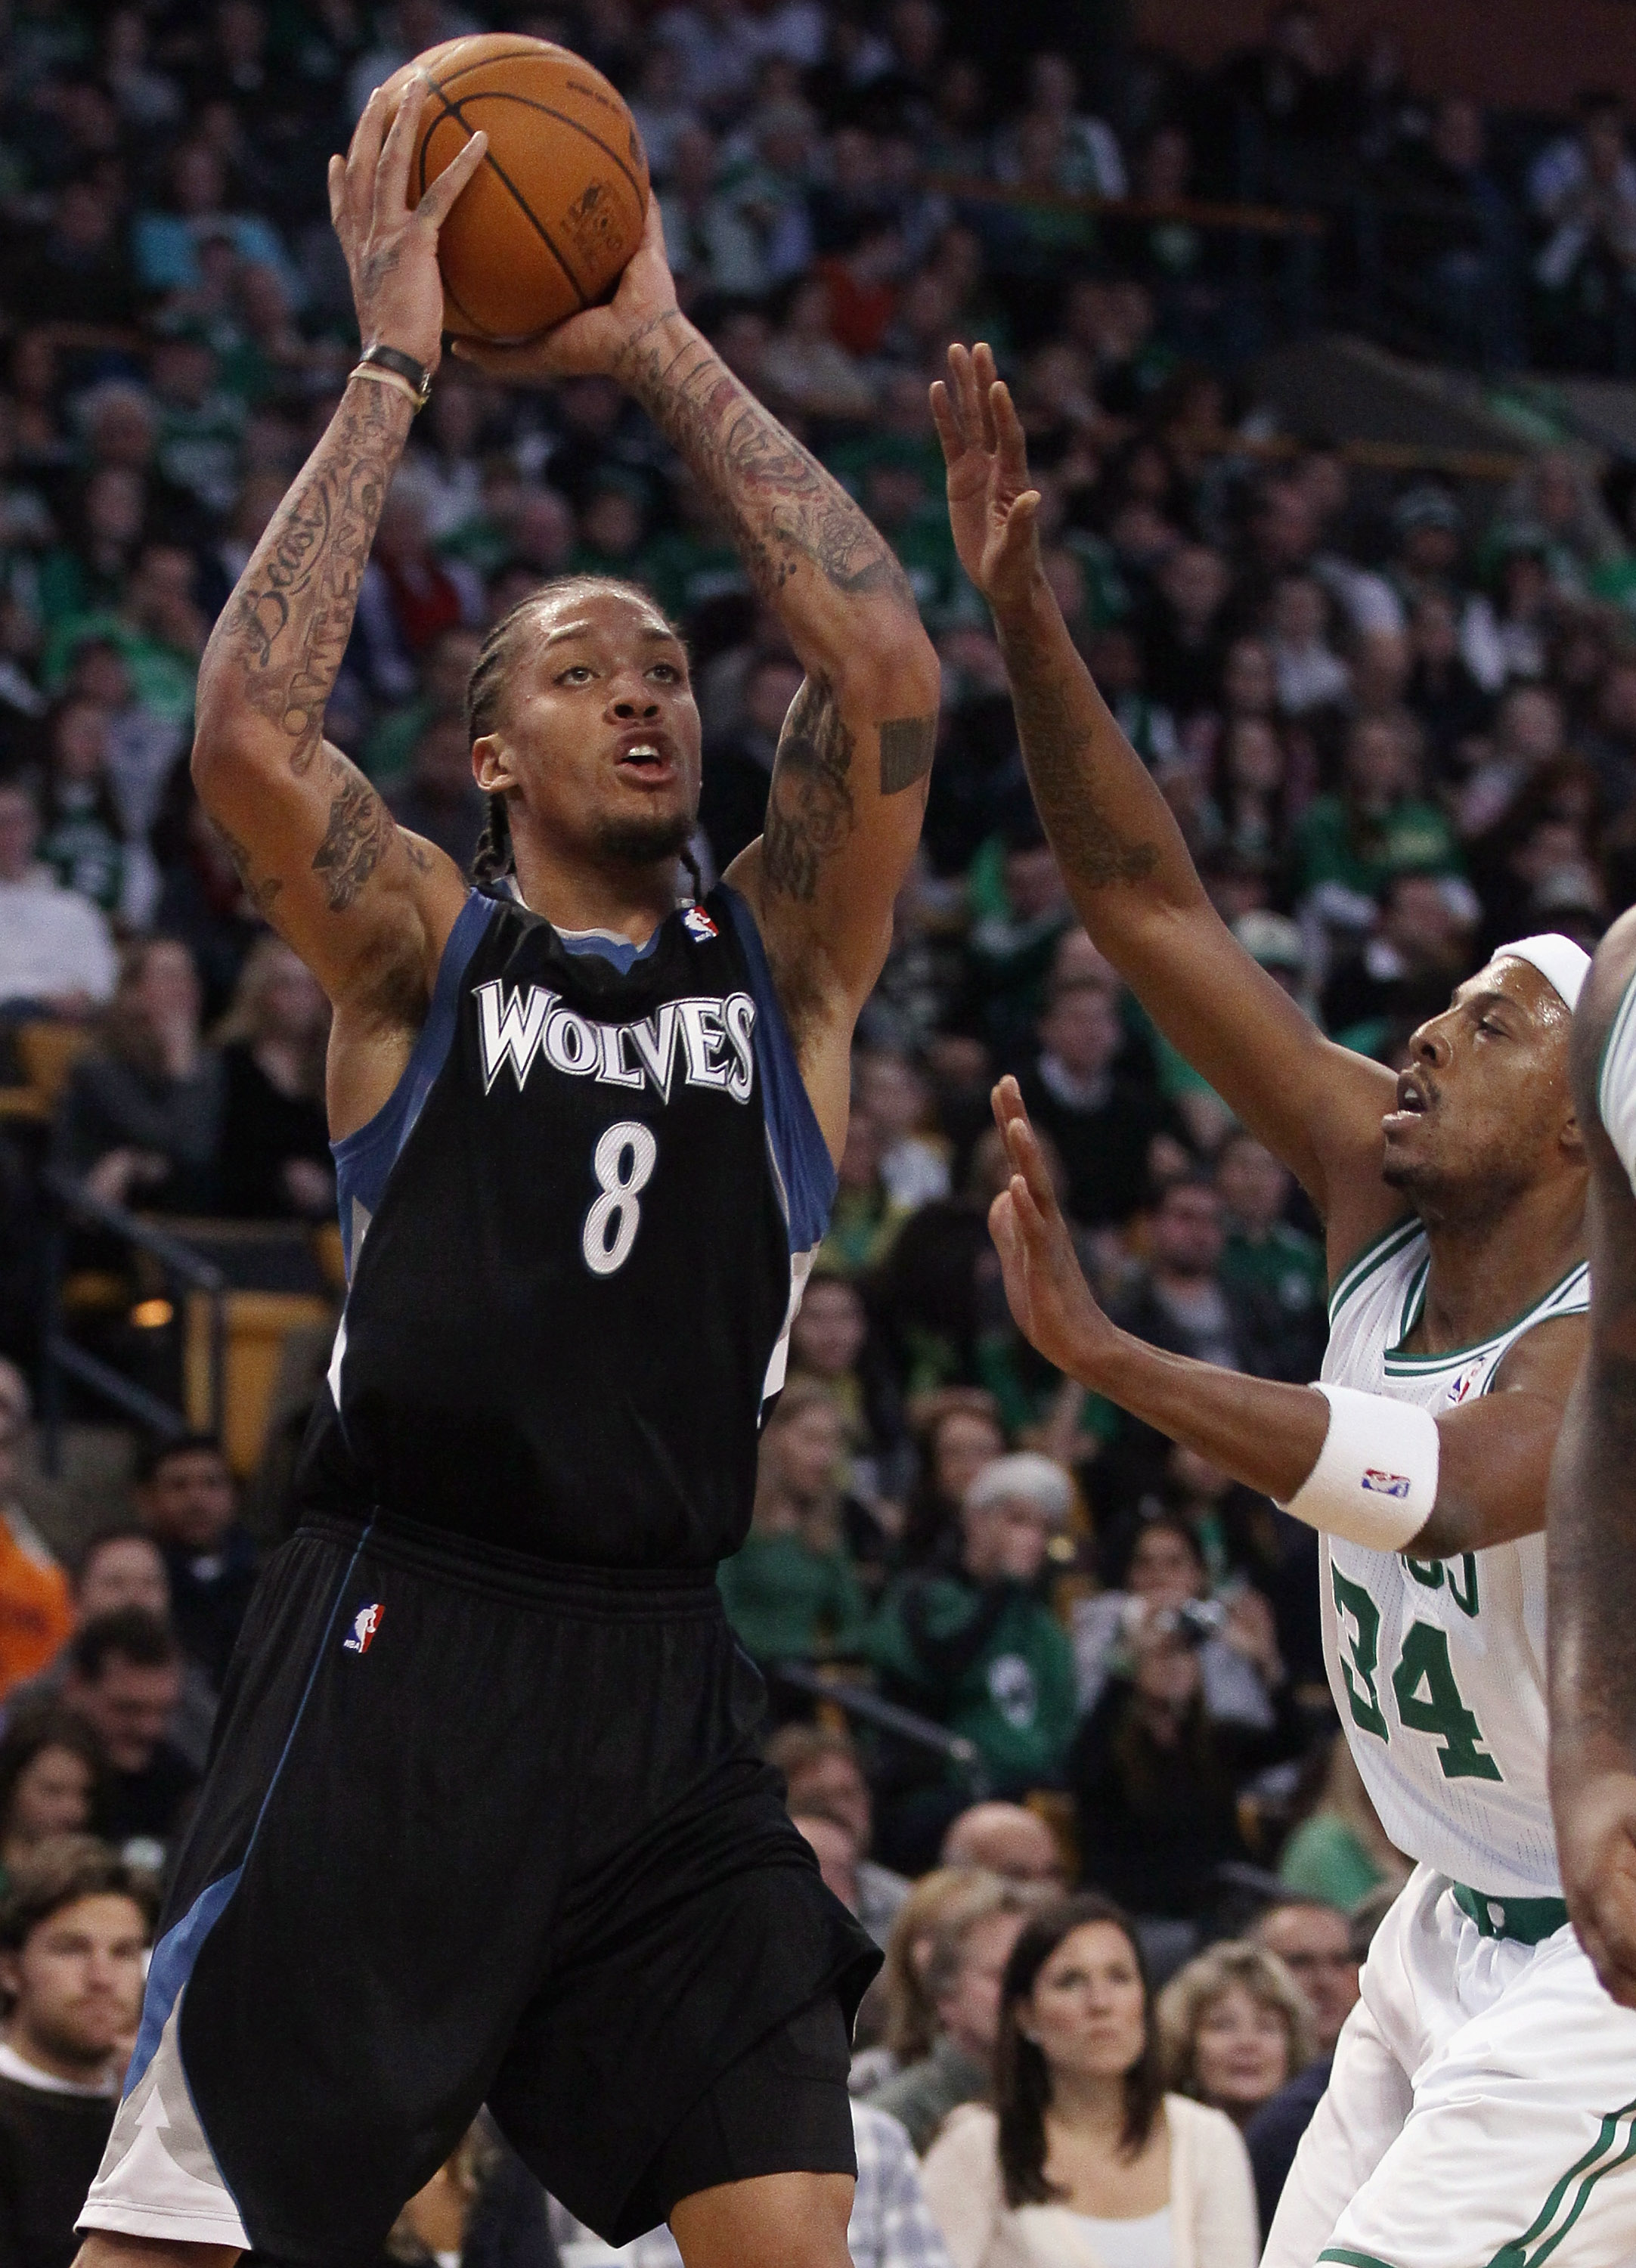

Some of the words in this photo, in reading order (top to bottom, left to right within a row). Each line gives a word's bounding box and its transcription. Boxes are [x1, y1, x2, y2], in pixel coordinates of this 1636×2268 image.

[471, 979, 757, 1106] WOLVES
[581, 1120, 658, 1276] 8
[1329, 1556, 1504, 1782] 34
